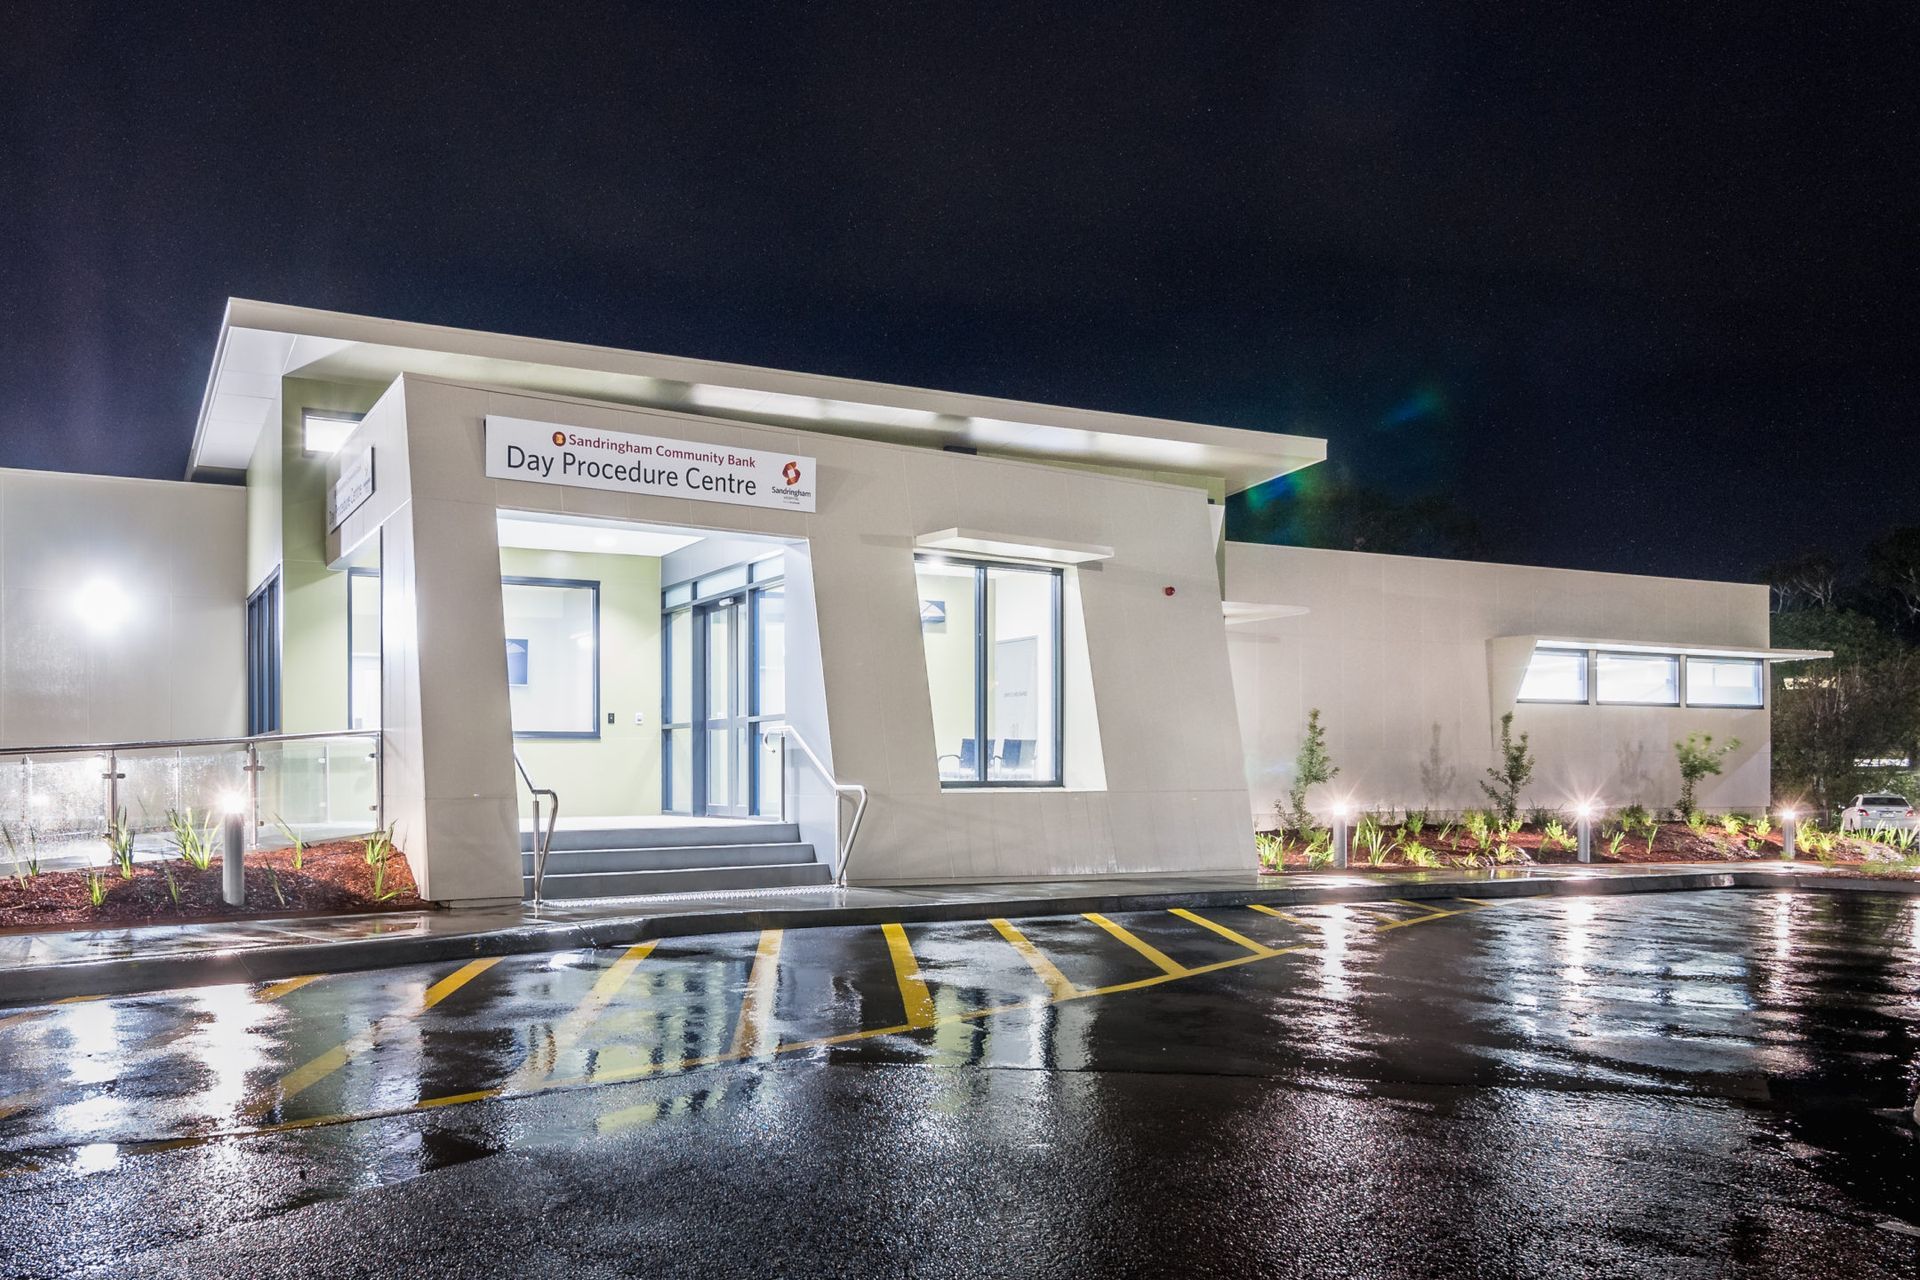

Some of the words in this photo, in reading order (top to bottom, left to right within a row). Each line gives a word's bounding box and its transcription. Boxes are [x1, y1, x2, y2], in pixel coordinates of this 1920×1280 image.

[568, 433, 652, 455] Sandringham
[656, 445, 725, 466] Community
[728, 454, 756, 468] Bank
[507, 445, 554, 478] Day
[563, 451, 678, 487] Procedure
[686, 467, 757, 496] Centre
[771, 486, 811, 498] Sandringham
